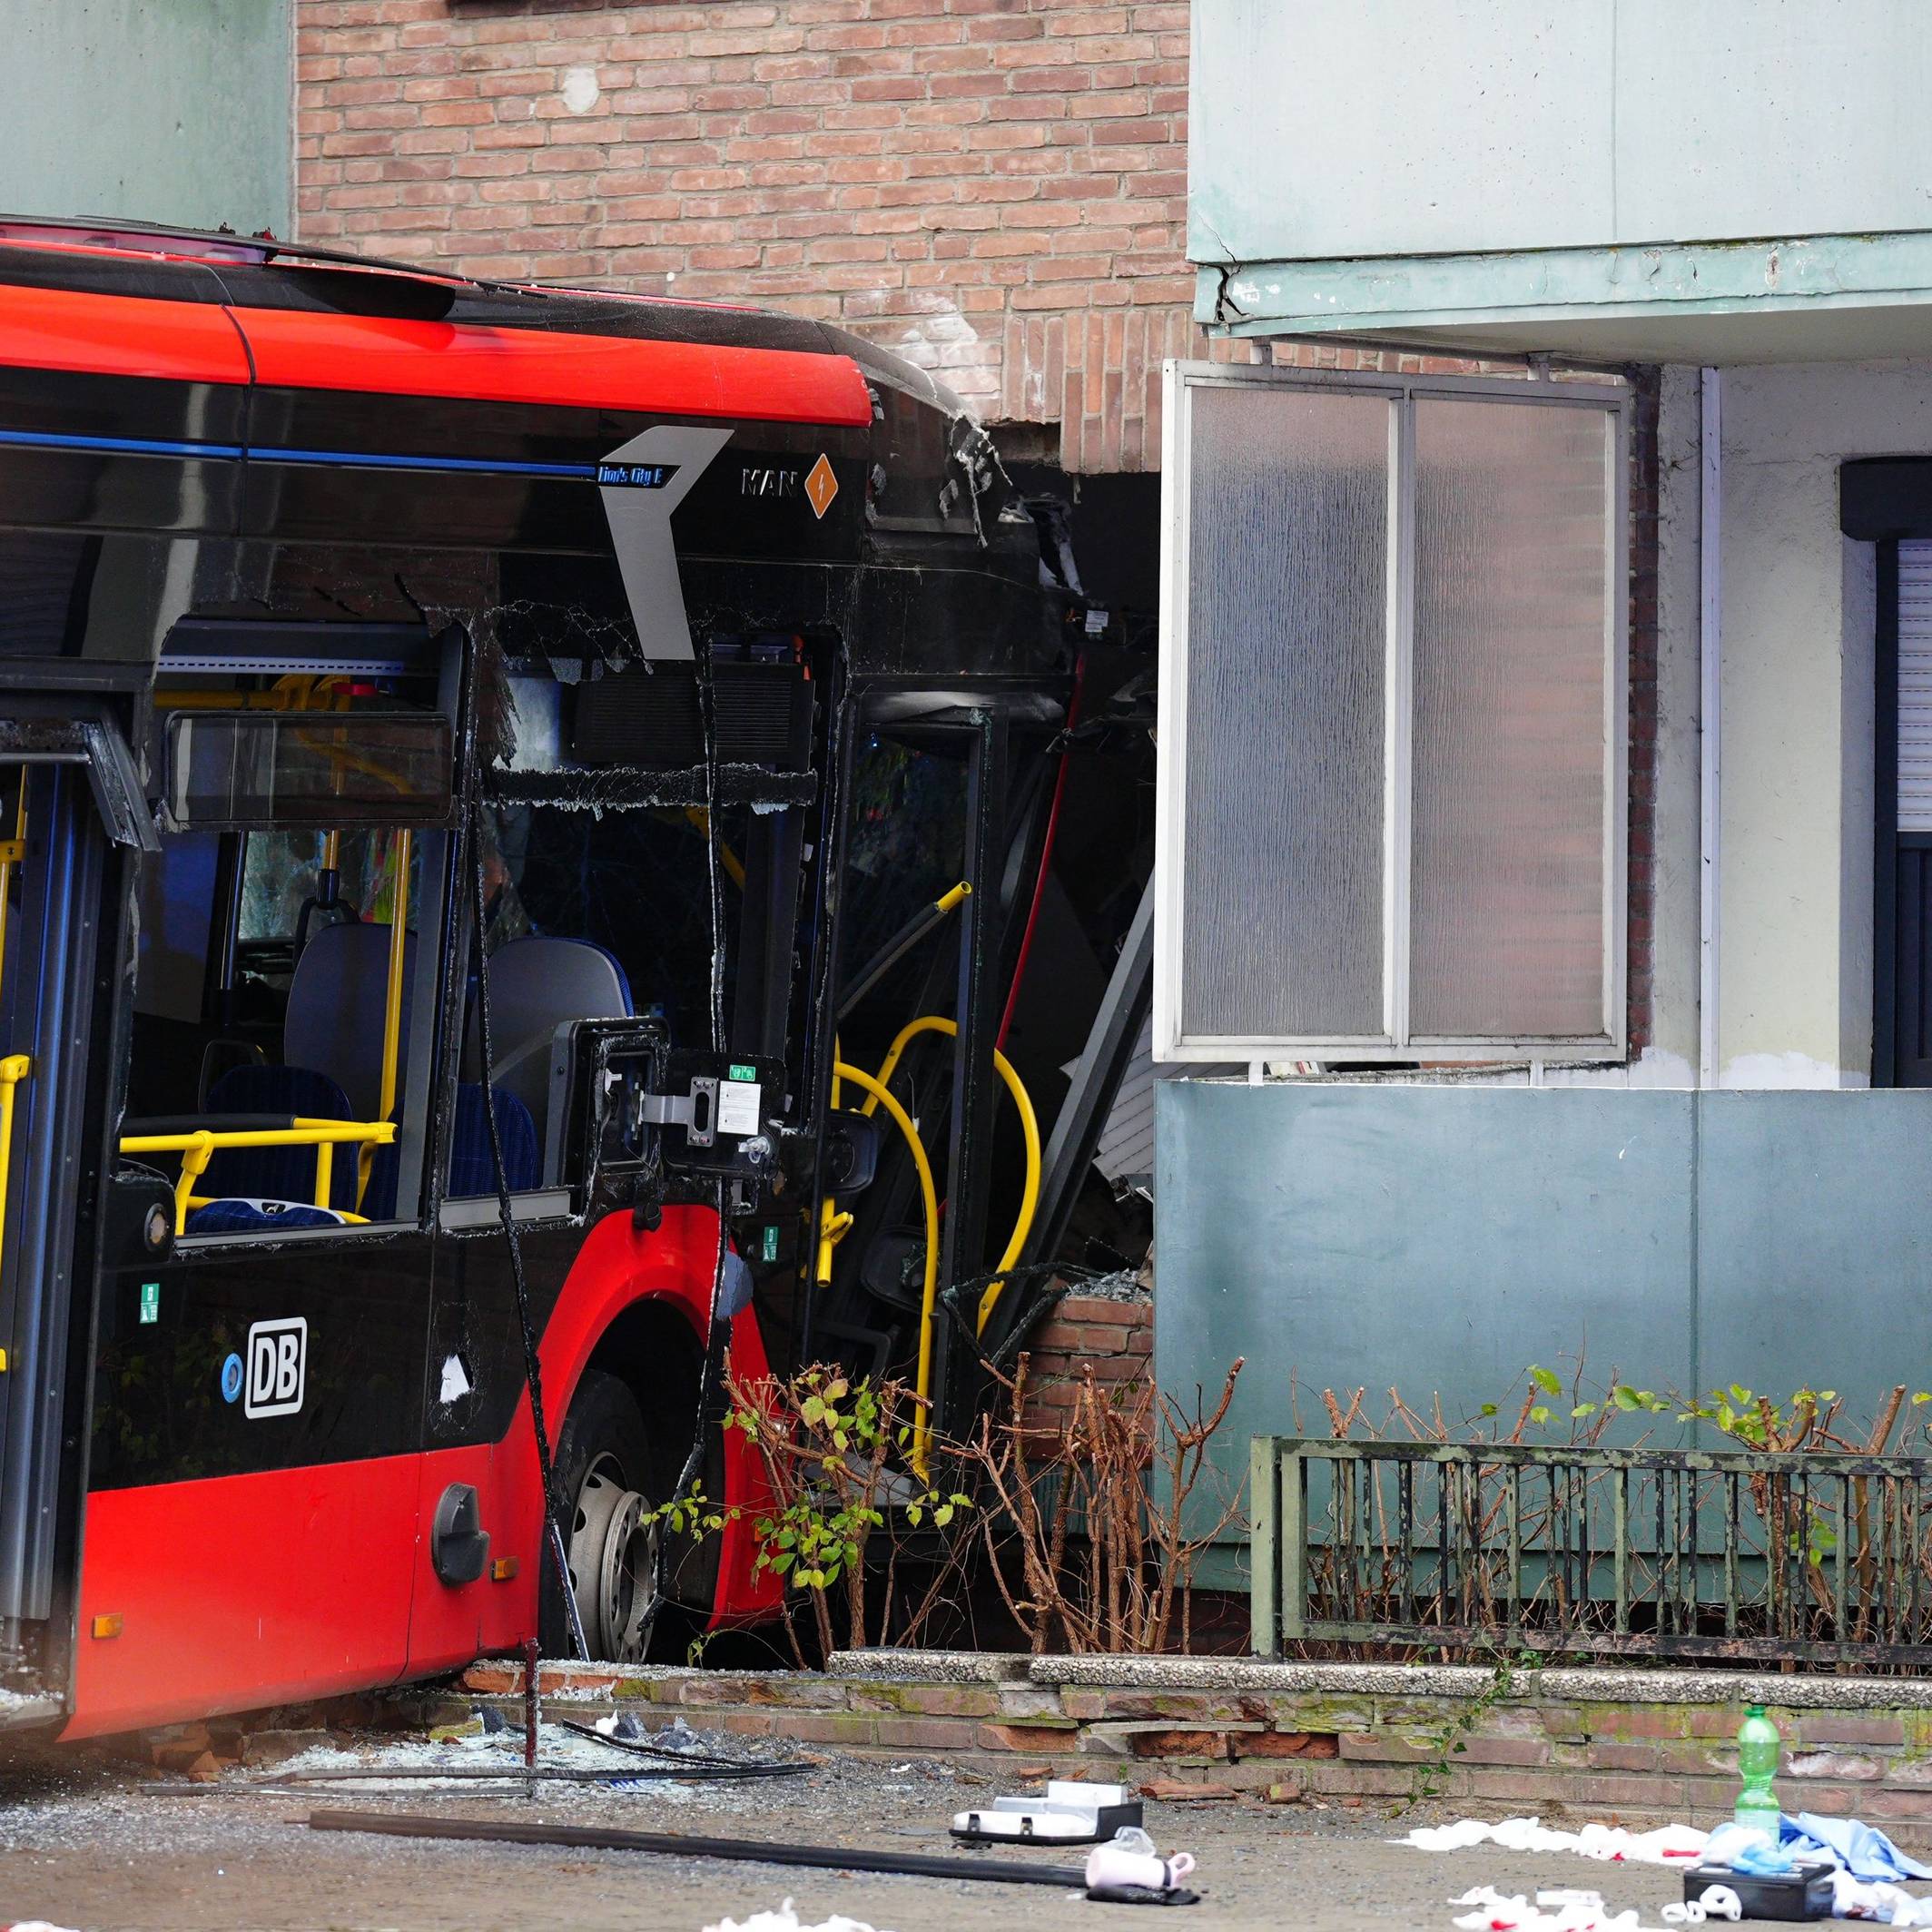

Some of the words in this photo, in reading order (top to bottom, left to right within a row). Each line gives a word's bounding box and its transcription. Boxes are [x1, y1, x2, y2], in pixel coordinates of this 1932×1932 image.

[597, 466, 628, 483] Lion's
[631, 468, 652, 487] City
[654, 468, 663, 484] E
[742, 468, 798, 497] MAN
[252, 1334, 299, 1403] DB
